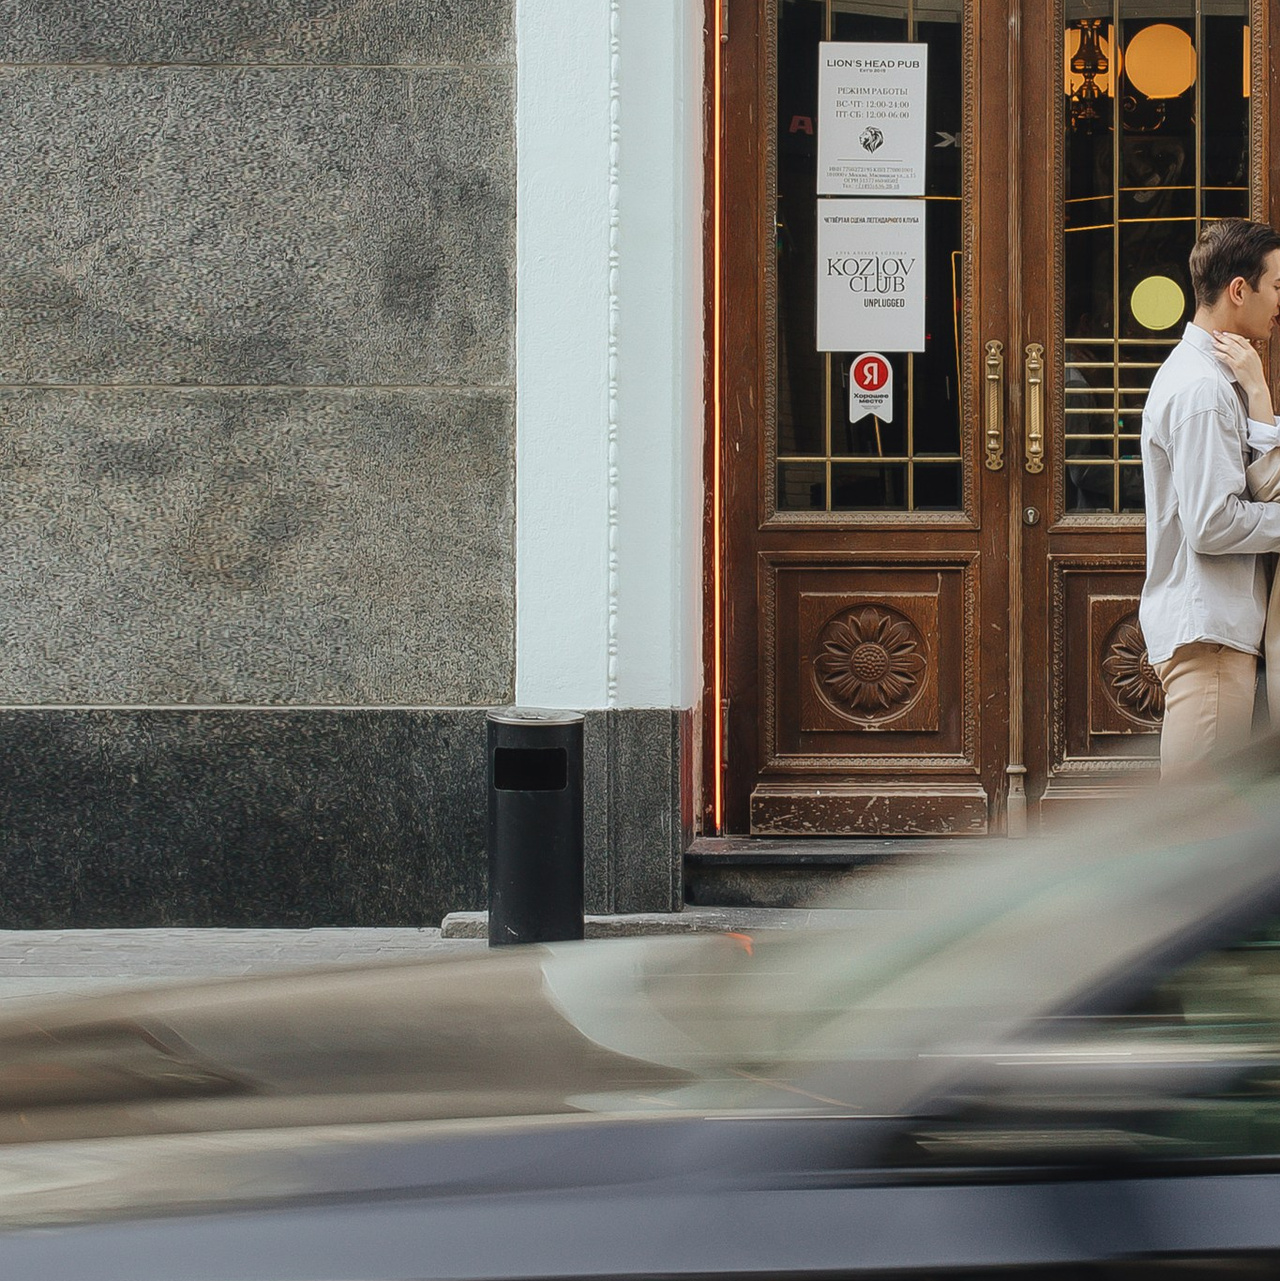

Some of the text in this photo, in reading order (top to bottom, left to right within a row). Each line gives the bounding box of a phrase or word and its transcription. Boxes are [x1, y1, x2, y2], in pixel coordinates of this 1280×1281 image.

[826, 59, 920, 69] LION'S HEAD PUB
[837, 87, 908, 96] РЕЖИМ РАБОТЫ
[827, 256, 916, 277] KOZLOV
[849, 275, 905, 294] CLUB
[863, 298, 905, 308] UNPLUGGED
[862, 362, 878, 385] Я
